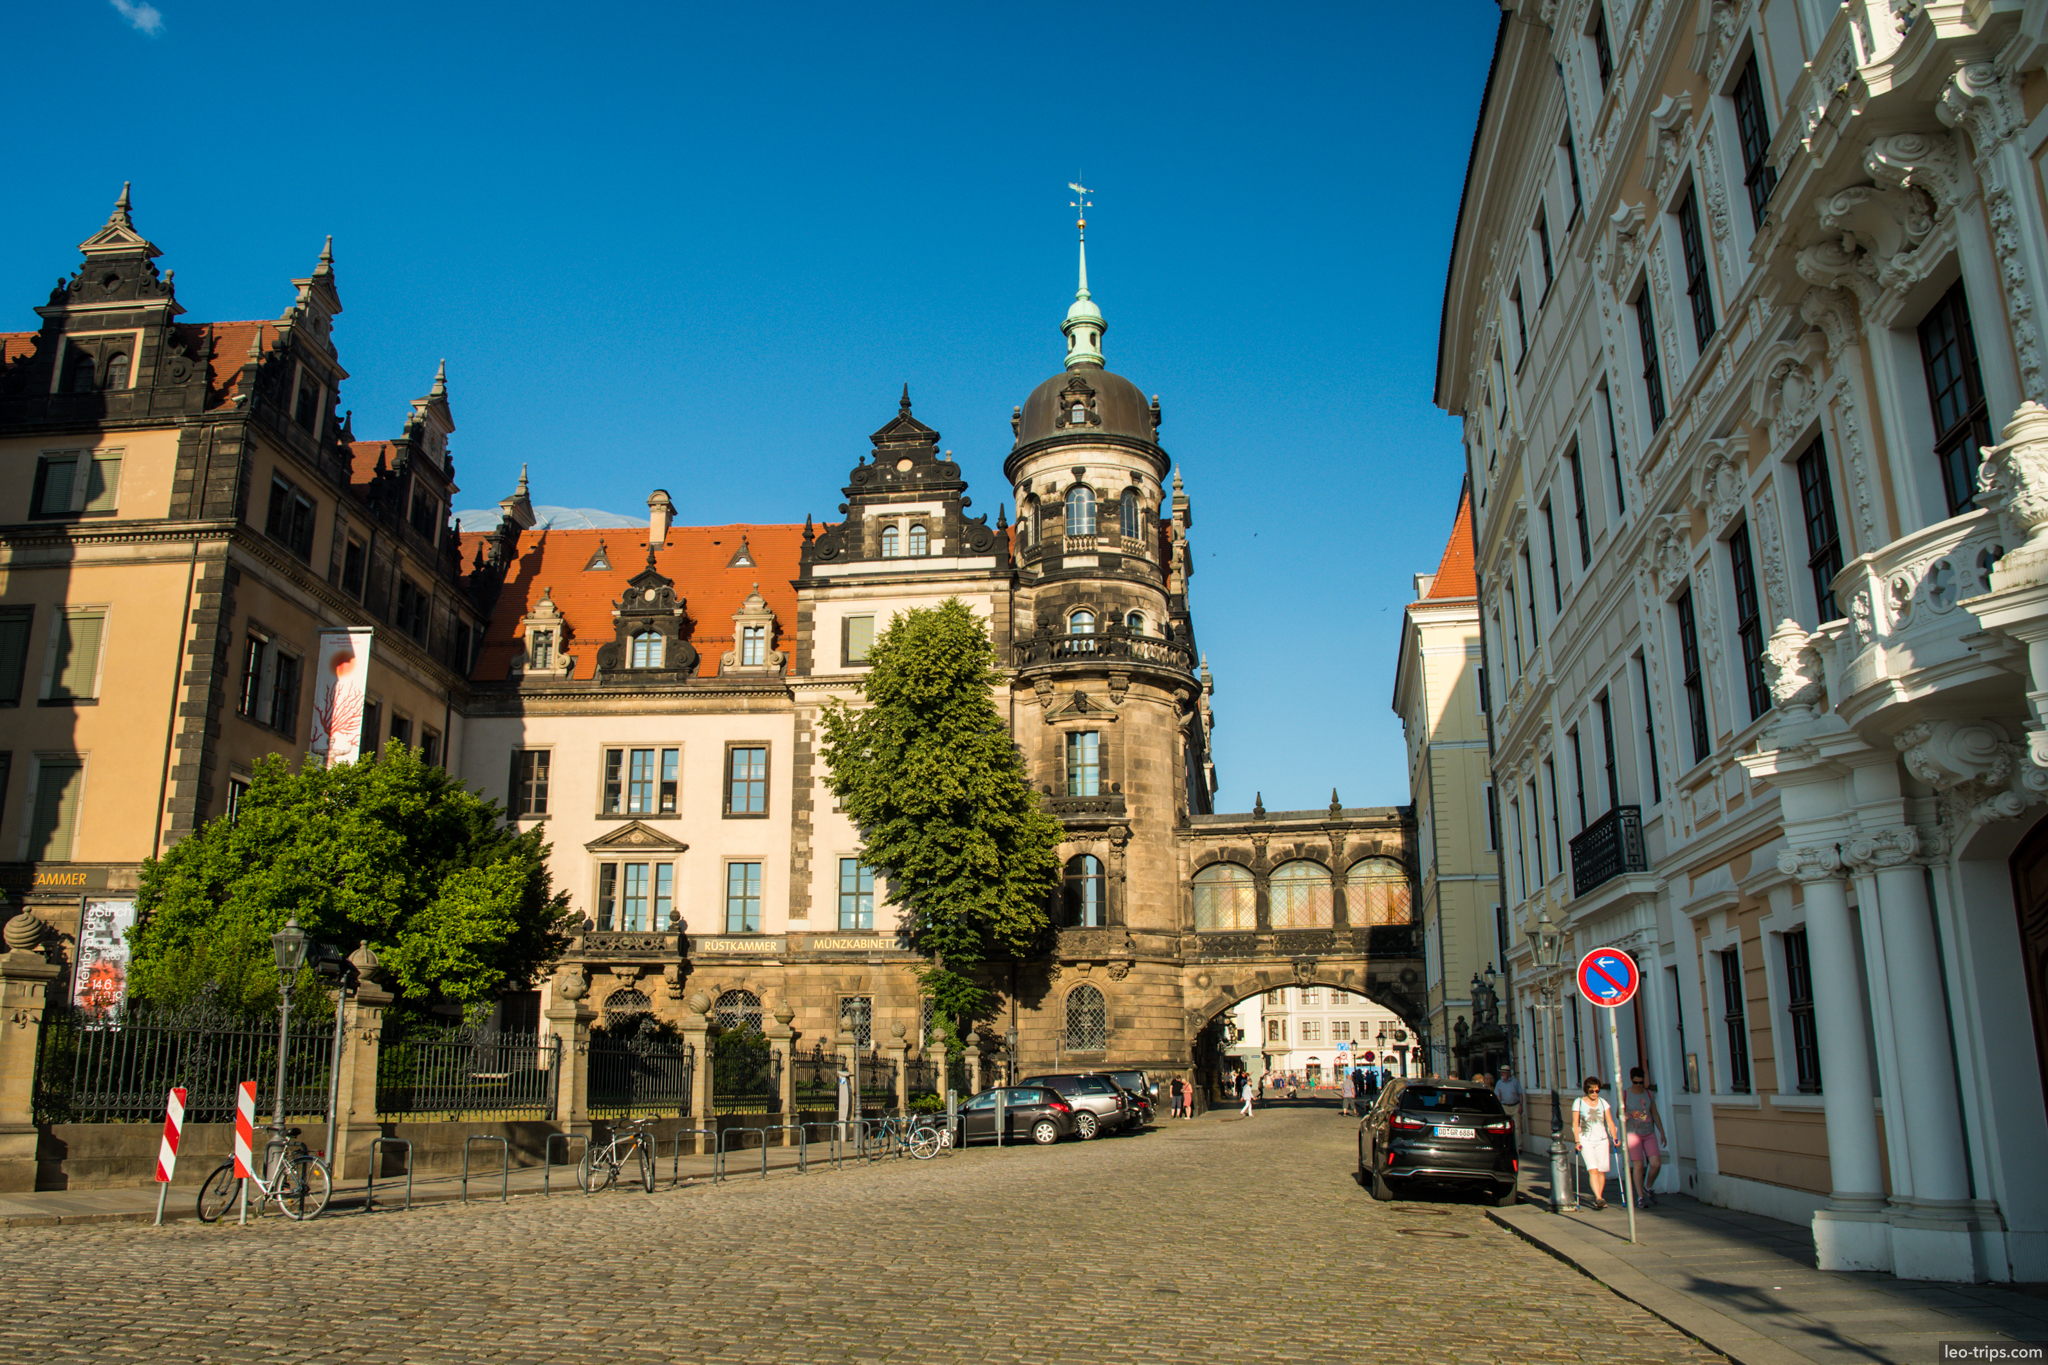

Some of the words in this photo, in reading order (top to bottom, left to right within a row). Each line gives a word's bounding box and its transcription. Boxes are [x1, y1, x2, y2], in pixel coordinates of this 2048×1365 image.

[29, 872, 87, 886] CAMMER
[96, 904, 132, 917] Strich
[78, 905, 97, 990] Rembrandts
[704, 939, 777, 951] RÜSTKAMMER
[813, 937, 898, 949] MÜNZKABINETT
